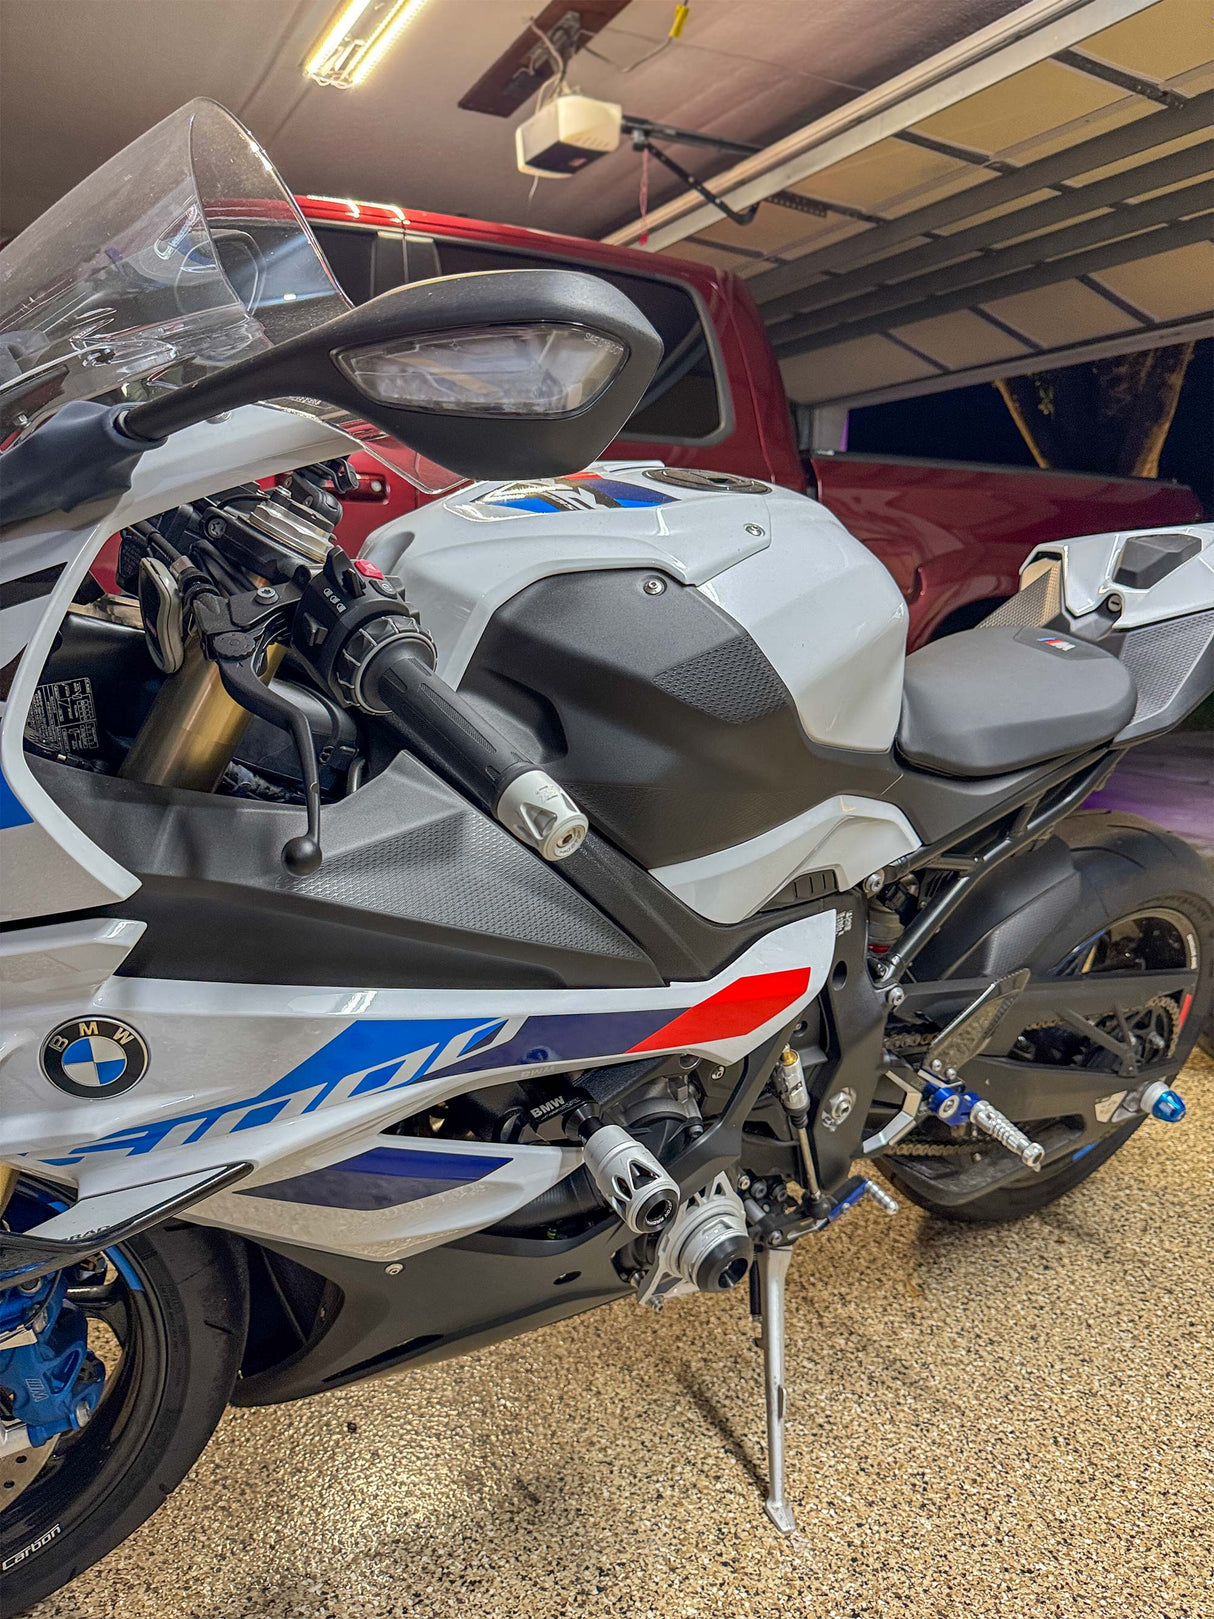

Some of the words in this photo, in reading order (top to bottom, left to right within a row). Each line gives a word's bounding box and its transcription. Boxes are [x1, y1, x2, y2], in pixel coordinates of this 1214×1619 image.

[48, 1021, 135, 1053] BMW
[530, 1096, 565, 1118] BMW
[2, 1523, 62, 1571] Carbon
